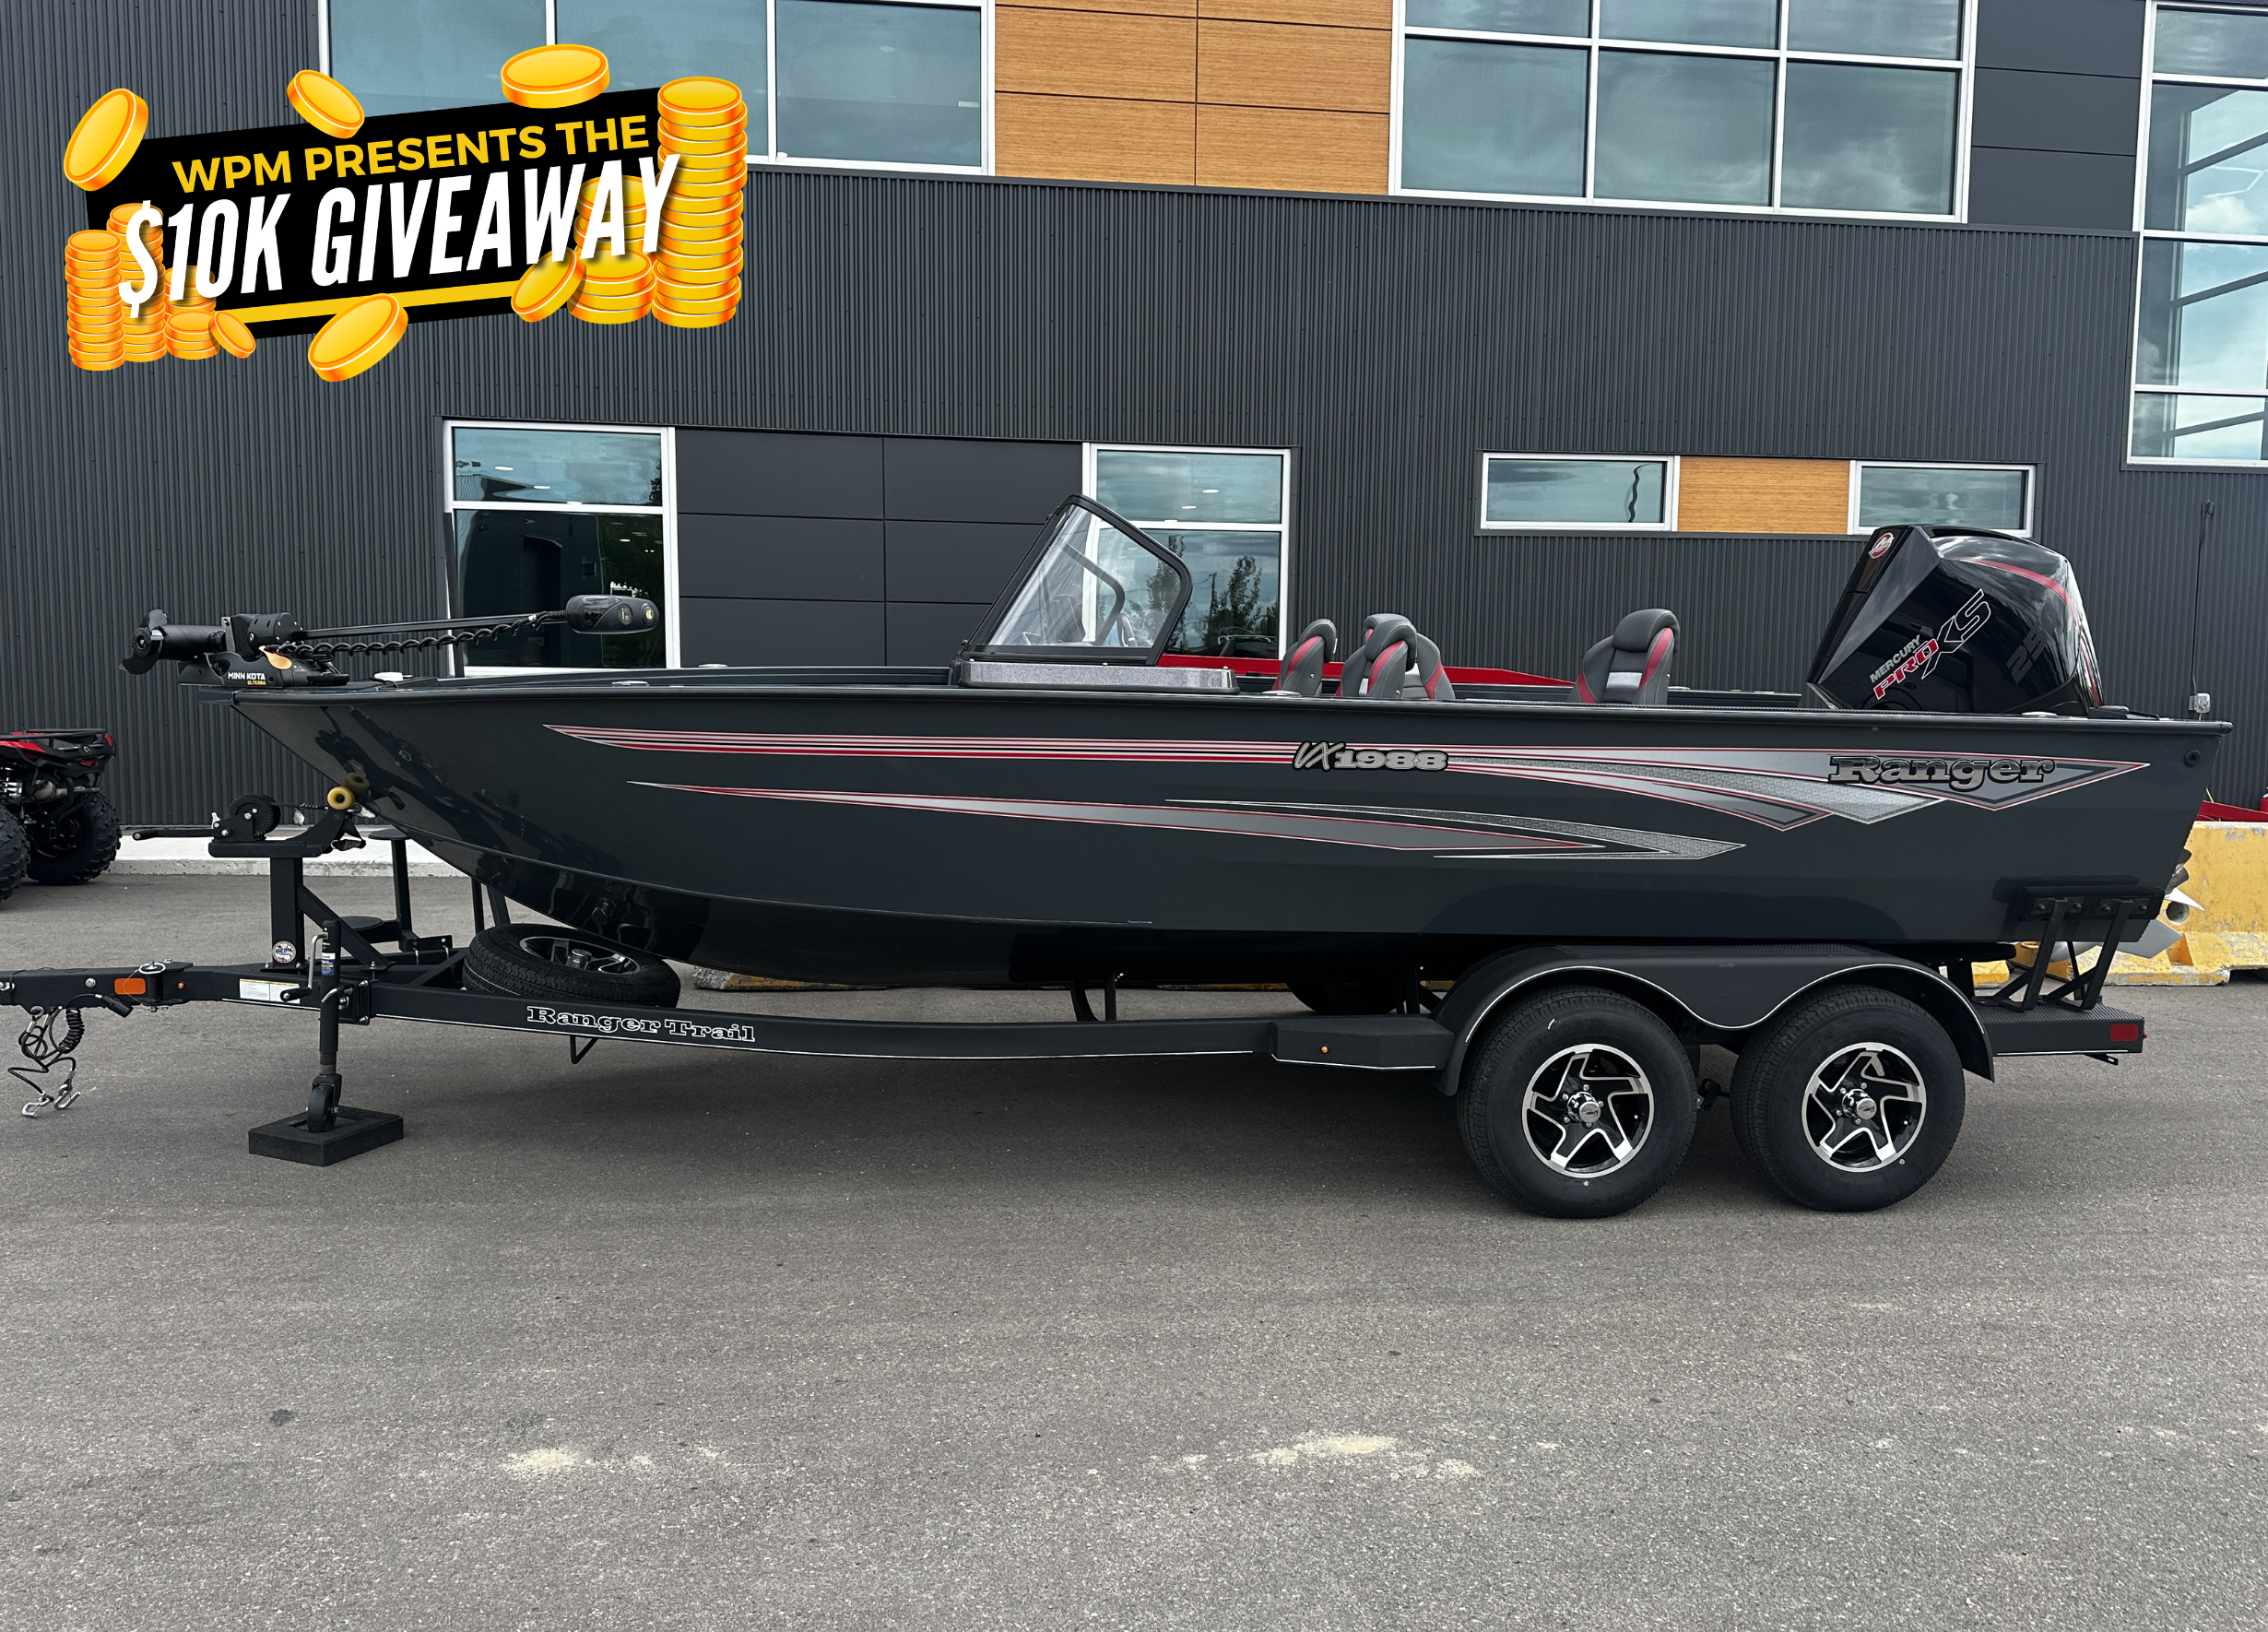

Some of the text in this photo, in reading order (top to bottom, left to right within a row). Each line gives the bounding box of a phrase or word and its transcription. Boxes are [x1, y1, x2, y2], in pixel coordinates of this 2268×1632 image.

[227, 671, 266, 680] MINN KOTA
[1869, 634, 1920, 683] MERCURY
[1829, 755, 2056, 792] Ranger
[526, 1005, 756, 1043] Ranger Trail
